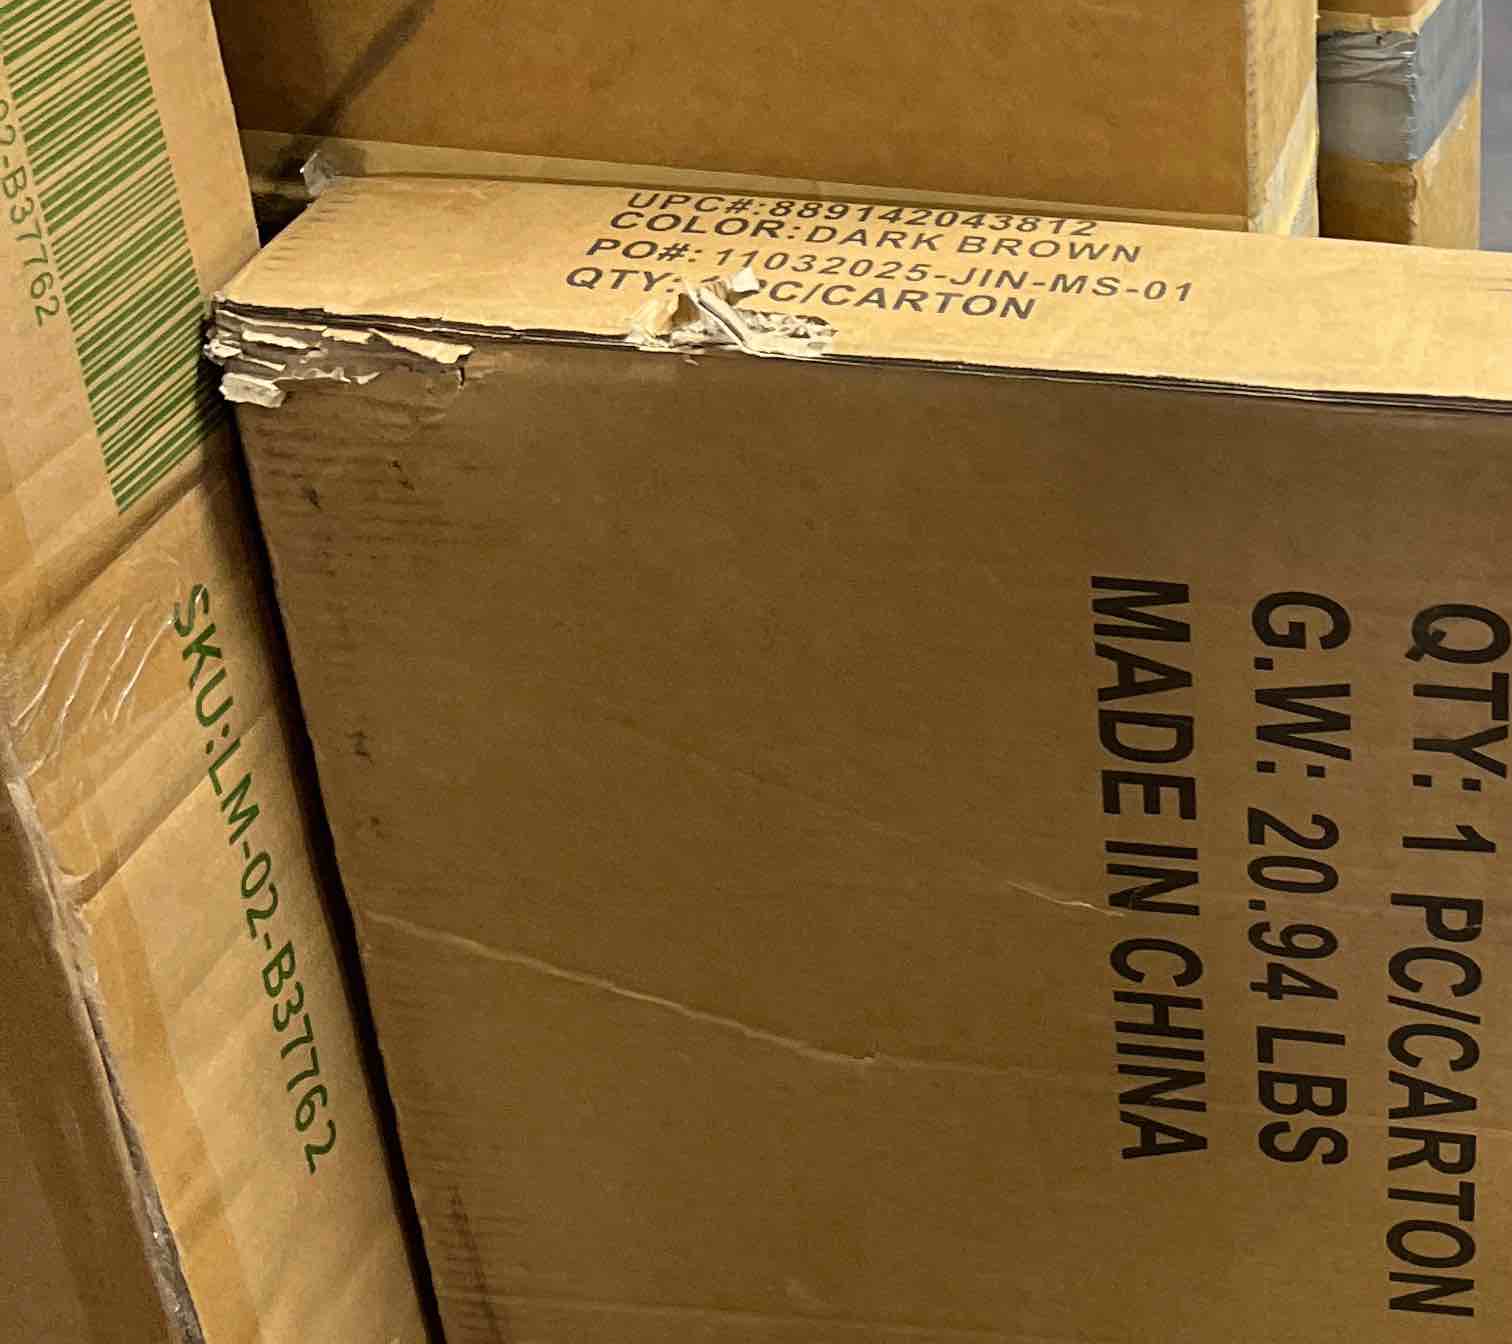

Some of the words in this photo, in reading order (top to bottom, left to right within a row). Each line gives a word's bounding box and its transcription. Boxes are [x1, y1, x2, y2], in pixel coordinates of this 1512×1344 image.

[566, 267, 681, 293] QTY:
[758, 279, 1038, 320] C/CARTON
[586, 238, 704, 263] PO#:
[716, 247, 1194, 303] 11032025-JIN-MS-01
[956, 235, 1142, 265] BROWN
[1091, 575, 1198, 821] MADE
[1250, 591, 1352, 778] G.W:
[1403, 603, 1512, 793] QTY:
[172, 583, 337, 1174] SKU:LM-02-B37762
[1105, 839, 1200, 916] IN
[1247, 807, 1340, 1001] 20.94
[1401, 824, 1497, 854] 1
[1109, 937, 1208, 1160] CHINA
[1256, 1025, 1348, 1166] LBS
[1385, 892, 1484, 1318] PC/CARTON
